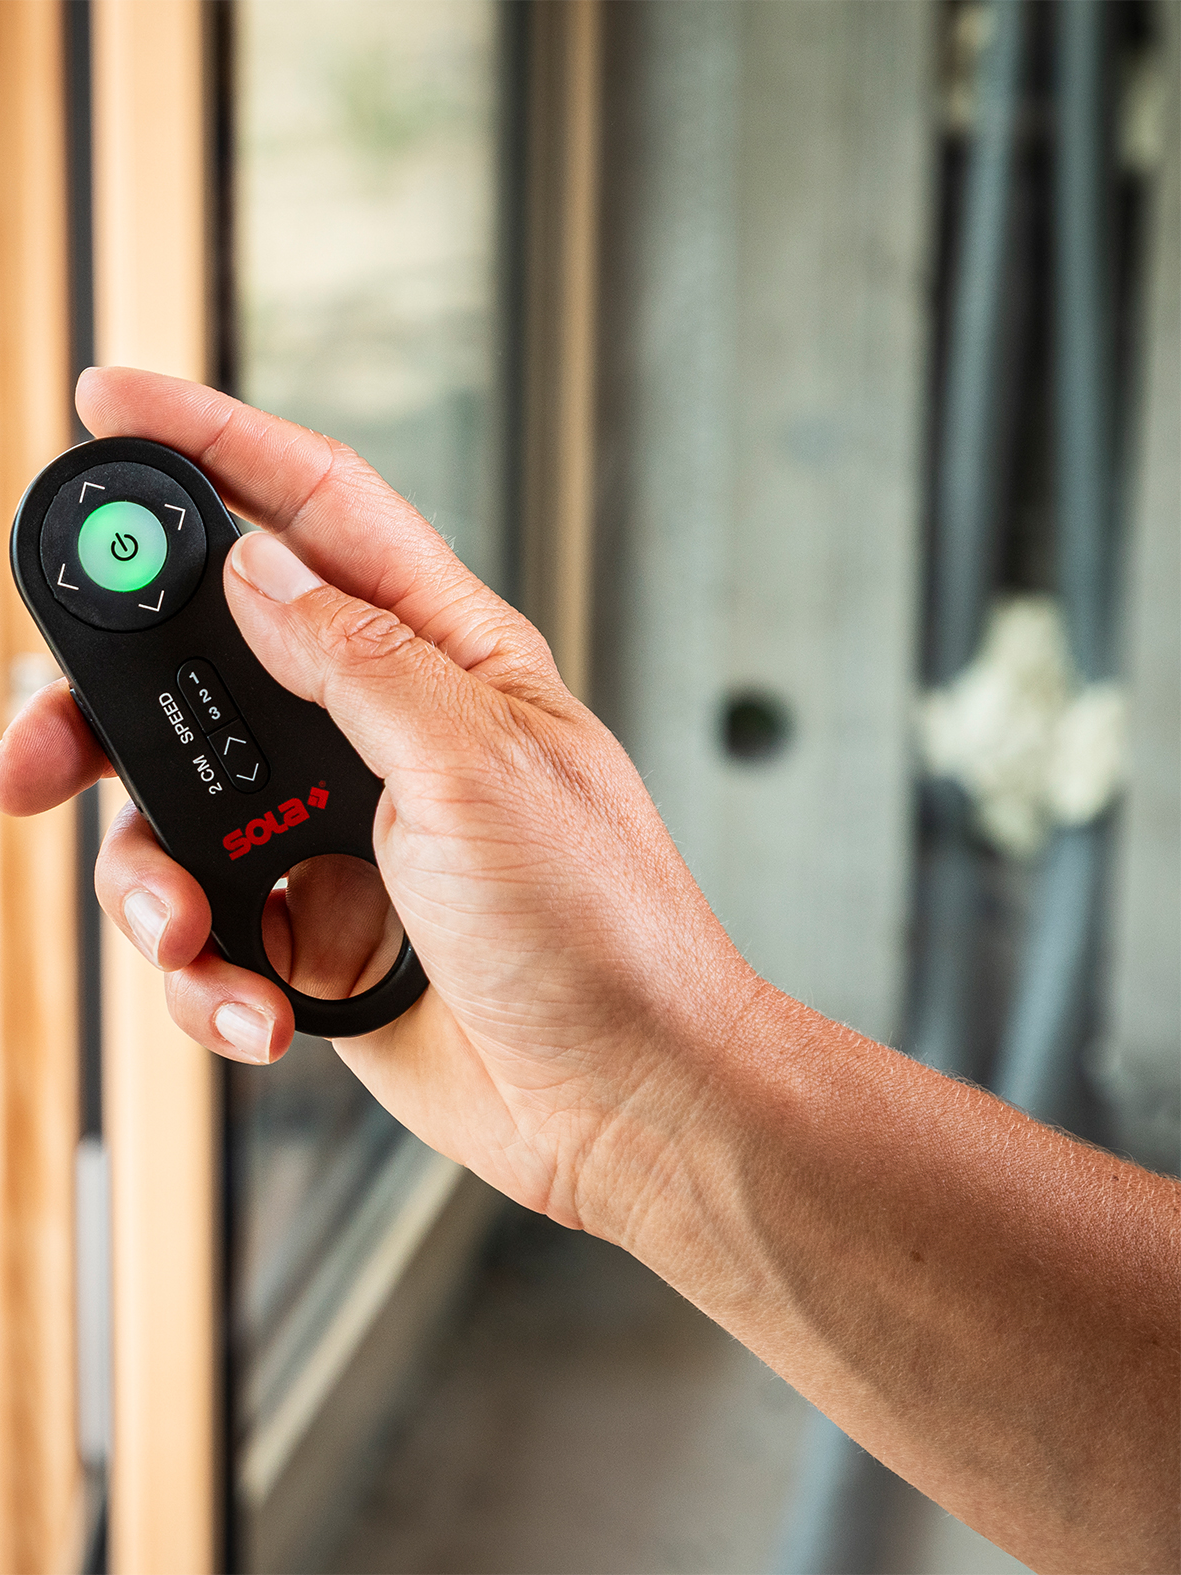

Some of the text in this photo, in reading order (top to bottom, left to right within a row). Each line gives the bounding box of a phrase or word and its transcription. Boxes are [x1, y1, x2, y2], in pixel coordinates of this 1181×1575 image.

[188, 671, 200, 684] 1
[198, 688, 212, 703] 2
[208, 706, 221, 720] 3
[158, 692, 222, 795] 2 CM SPEED
